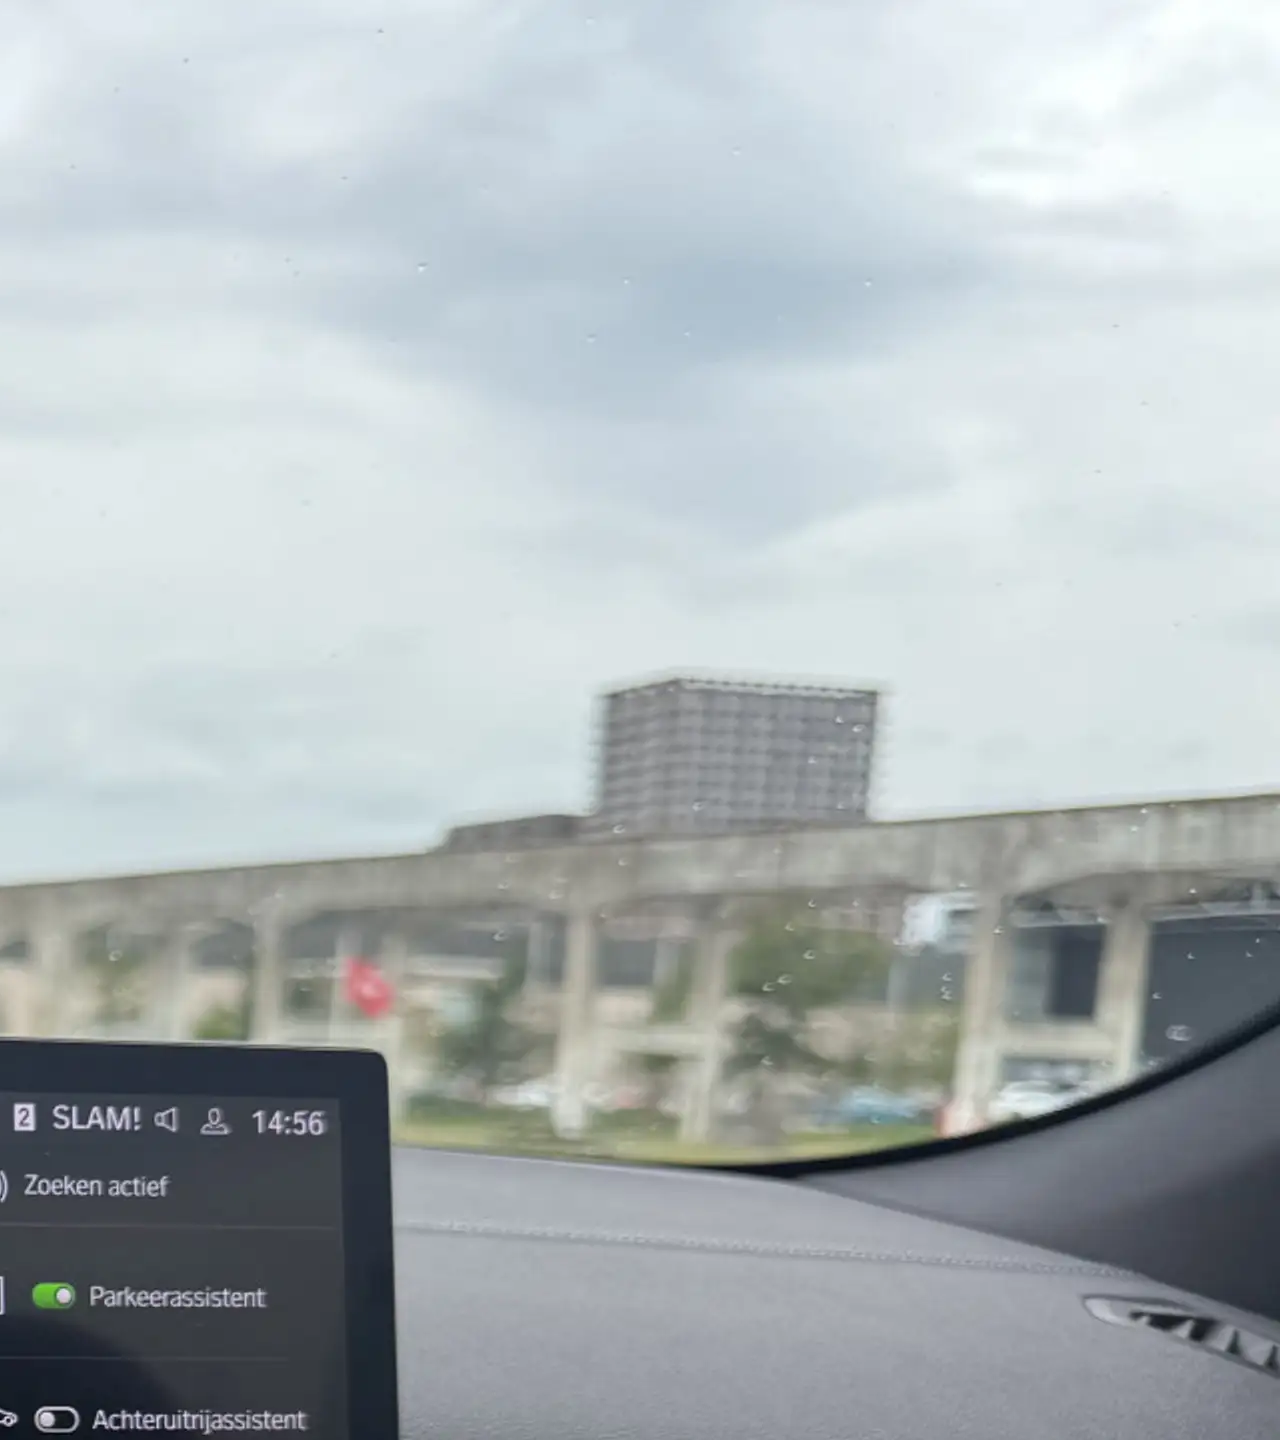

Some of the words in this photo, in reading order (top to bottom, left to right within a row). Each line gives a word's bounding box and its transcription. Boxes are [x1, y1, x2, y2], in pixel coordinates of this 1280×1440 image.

[52, 1104, 141, 1132] SLAM!
[251, 1110, 327, 1137] 14:56
[23, 1173, 103, 1198] Zoeken
[107, 1174, 171, 1199] actief
[89, 1284, 268, 1310] Parkeerassistent
[92, 1408, 308, 1435] Achteruitrijassistent
